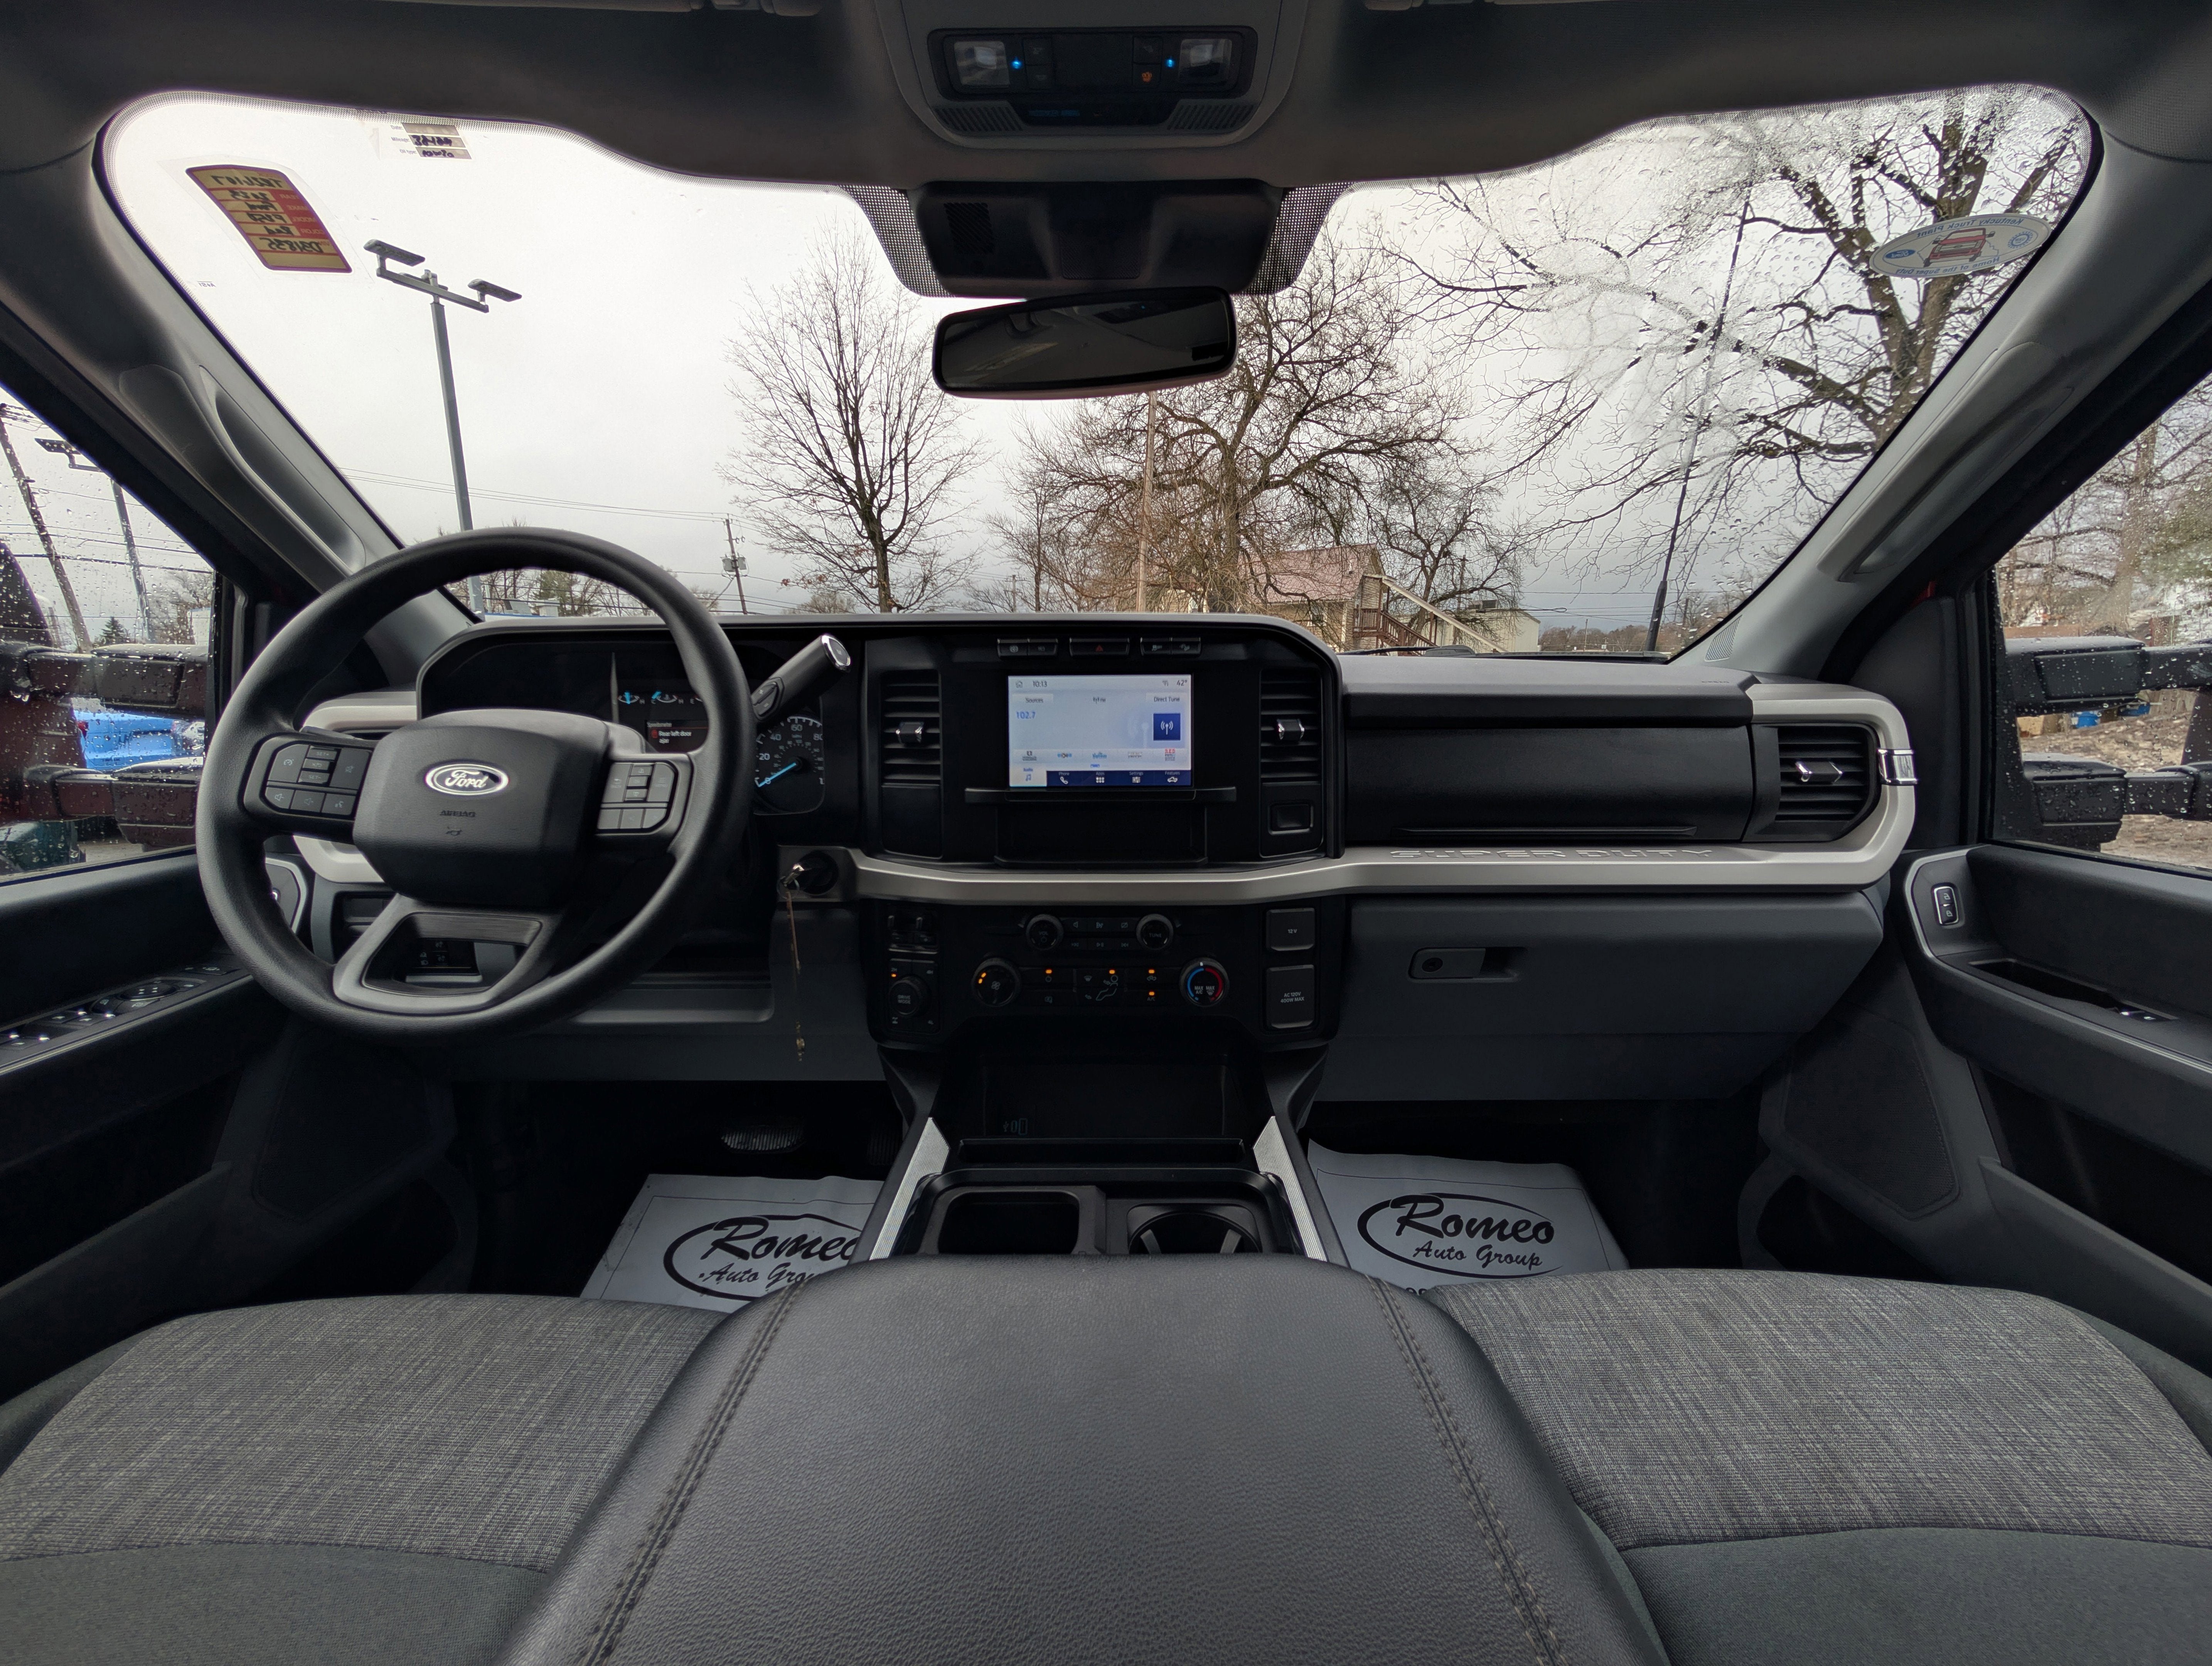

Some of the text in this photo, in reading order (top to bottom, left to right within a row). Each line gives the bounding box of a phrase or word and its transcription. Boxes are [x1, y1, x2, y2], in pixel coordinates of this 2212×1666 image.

[1016, 711, 1036, 719] 102.7
[445, 769, 489, 788] Ford
[1390, 850, 1567, 858] SUPER
[1389, 1195, 1555, 1244] Romeo
[1412, 1240, 1543, 1271] Auto Group
